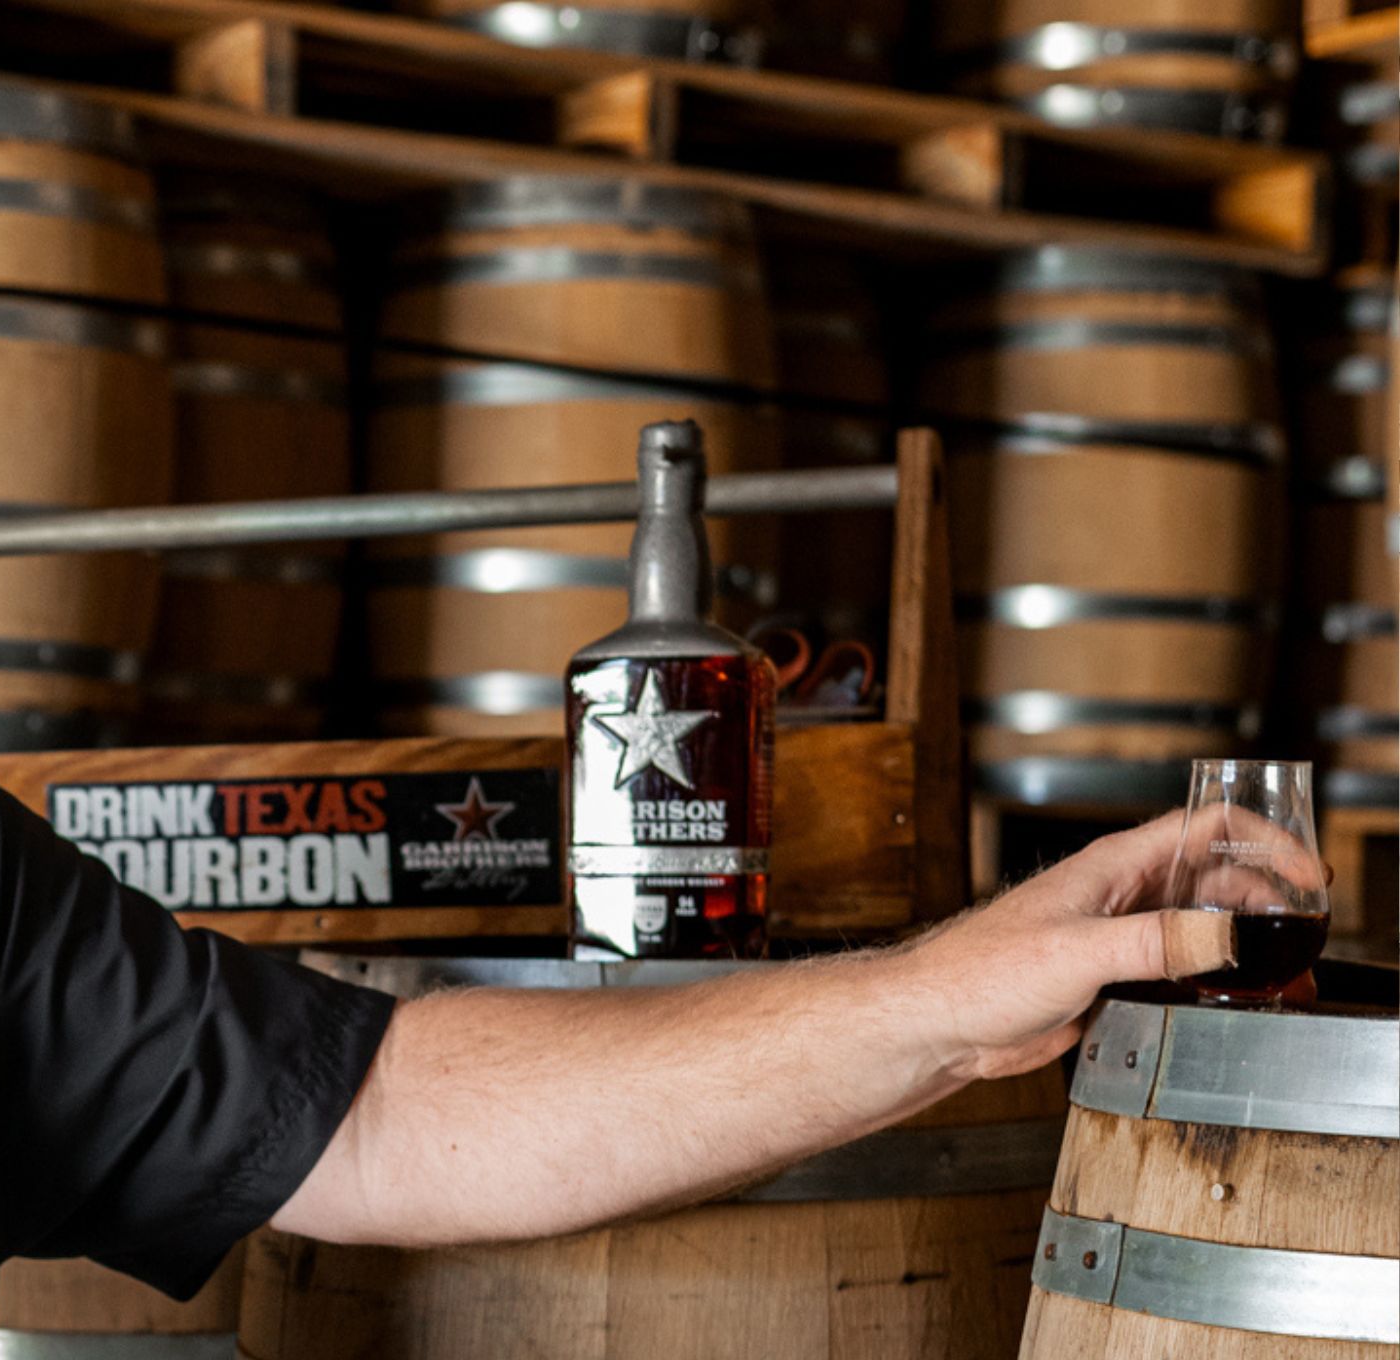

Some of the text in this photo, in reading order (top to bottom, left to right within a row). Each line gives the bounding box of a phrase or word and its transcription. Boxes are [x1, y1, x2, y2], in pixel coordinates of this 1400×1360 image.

[54, 780, 387, 839] DRINK TEXAS
[634, 800, 726, 819] RISON
[634, 821, 725, 841] THERS
[401, 839, 549, 856] GARRISON
[76, 832, 392, 909] OURBON
[403, 853, 551, 871] BROTHERS
